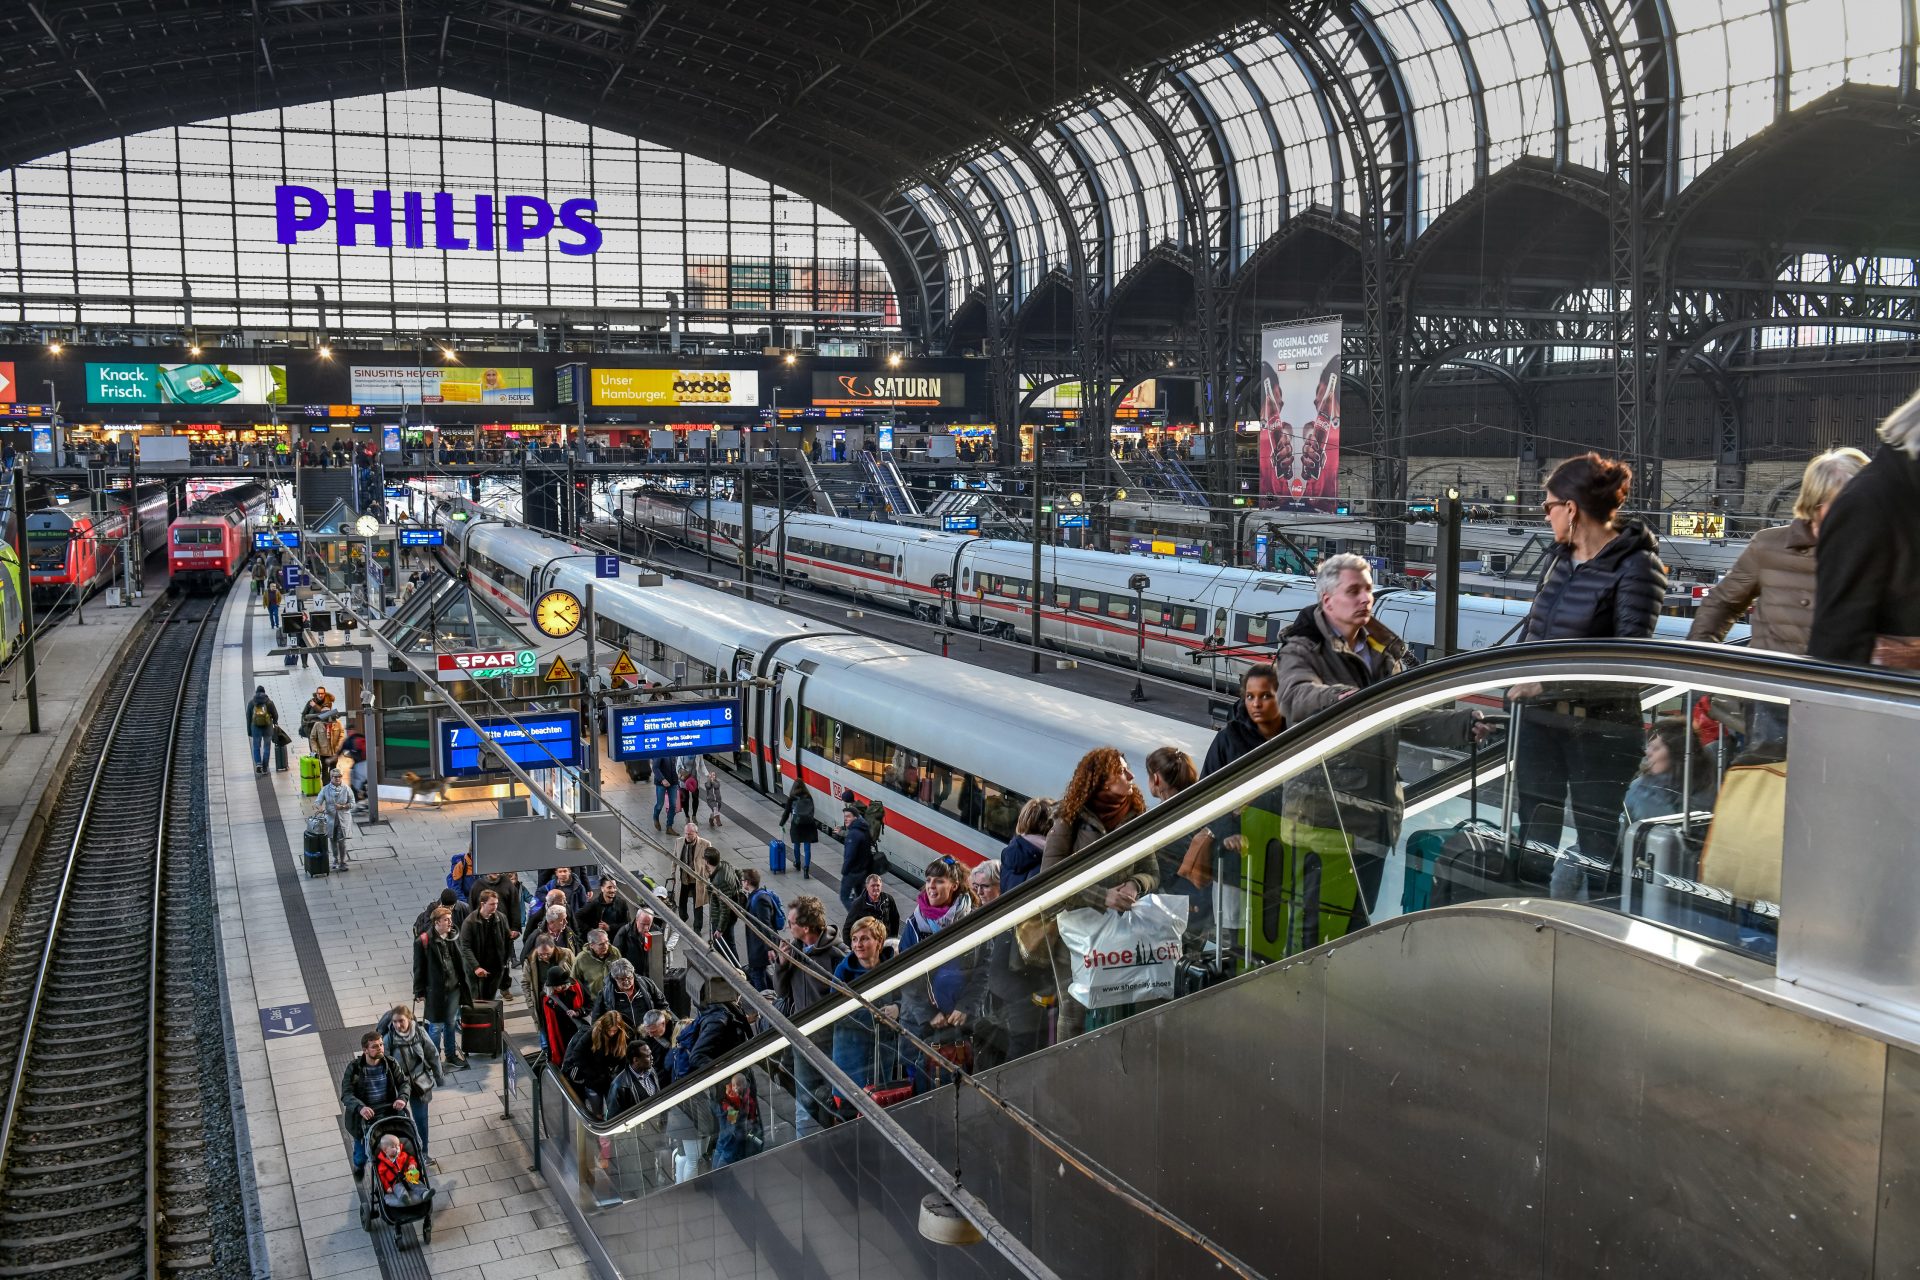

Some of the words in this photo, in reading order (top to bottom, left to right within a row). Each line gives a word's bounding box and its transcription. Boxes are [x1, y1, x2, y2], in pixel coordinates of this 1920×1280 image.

[275, 185, 603, 256] PHILIPS
[1272, 336, 1307, 348] ORIGINAL
[1308, 333, 1329, 345] COKE
[1277, 346, 1323, 359] GESCHMACK
[100, 367, 149, 381] Knack.
[354, 369, 404, 377] SINUSITIS
[406, 370, 445, 378] HEVERT
[601, 374, 633, 385] Unser
[101, 384, 147, 398] Frisch.
[601, 388, 667, 401] Hamburger.
[874, 377, 941, 398] SATURN
[604, 556, 619, 576] E
[286, 567, 300, 585] E
[1020, 585, 1025, 594] 2
[314, 598, 325, 607] v7
[1132, 604, 1136, 615] 2
[455, 653, 515, 668] SPAR
[472, 667, 536, 678] express
[724, 707, 732, 720] 8
[530, 726, 563, 735] beachten
[644, 722, 660, 731] Bitte
[661, 721, 677, 729] nicht
[678, 719, 711, 727] einsteigen
[835, 723, 841, 739] 2
[450, 729, 459, 743] 7
[833, 783, 842, 798] DB
[1083, 949, 1133, 969] shoe
[1156, 942, 1184, 961] city
